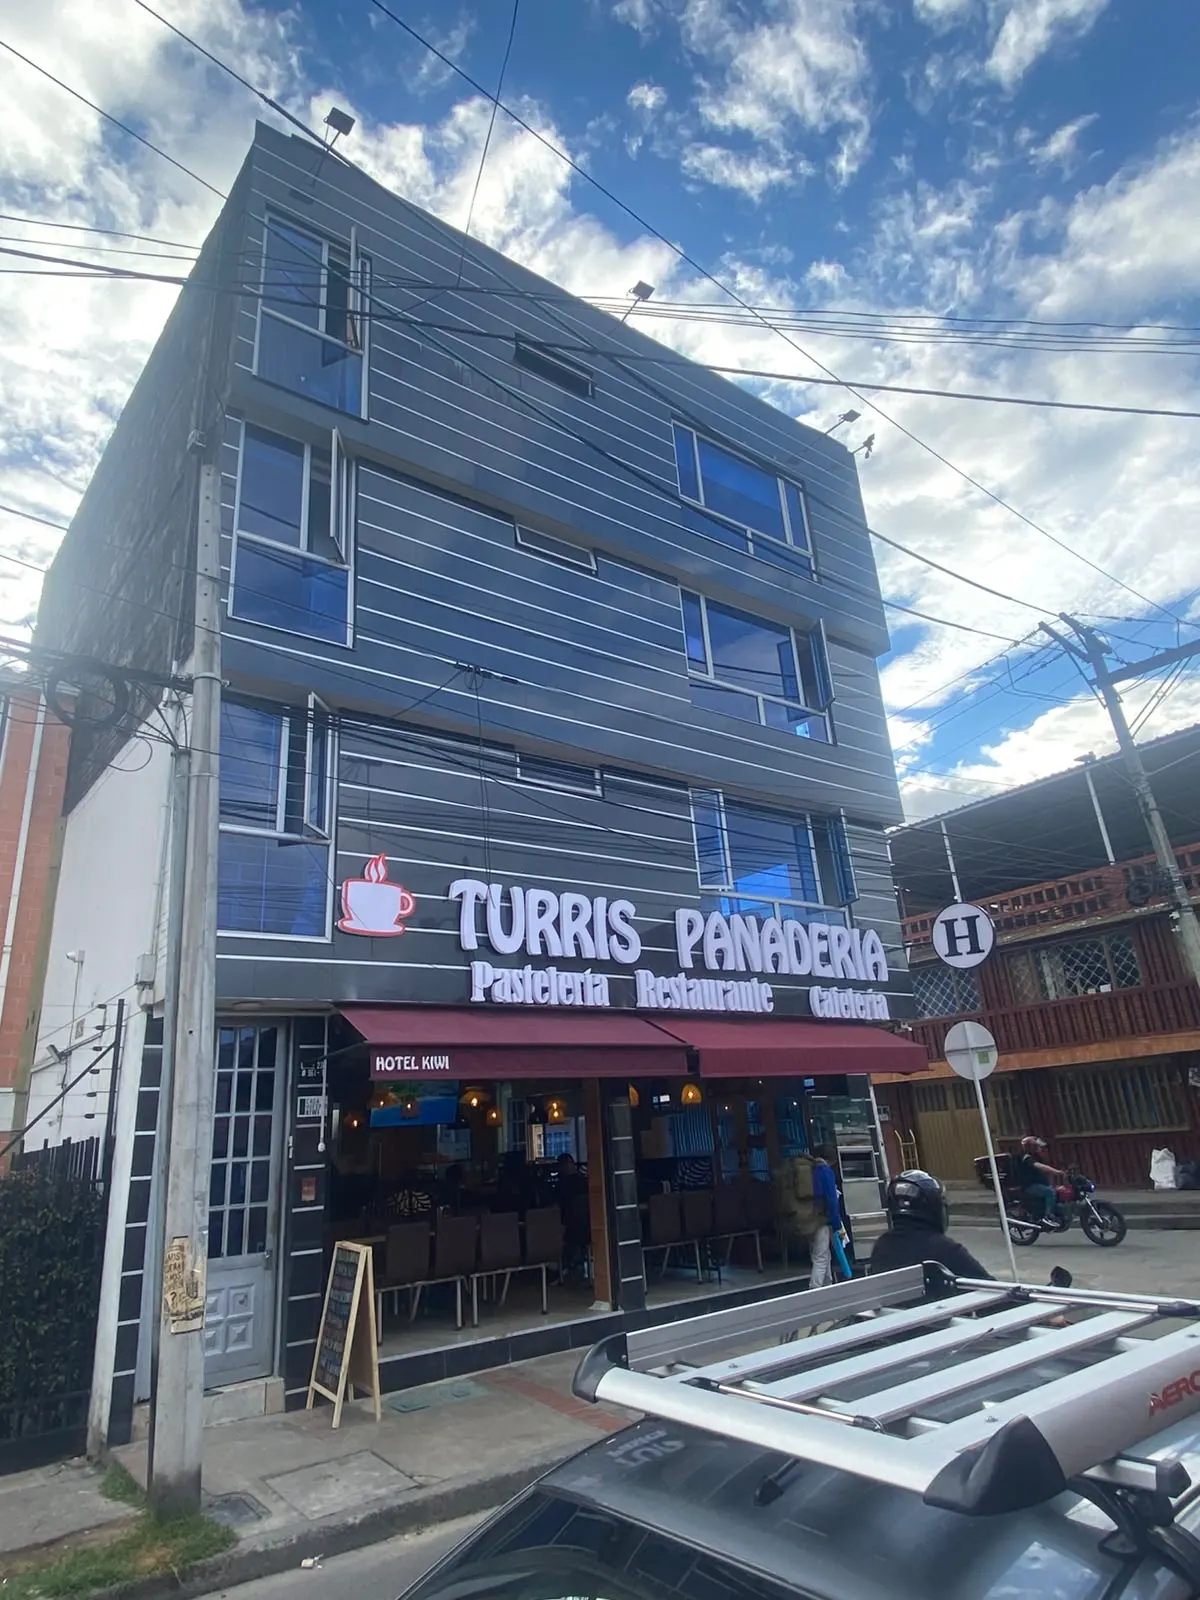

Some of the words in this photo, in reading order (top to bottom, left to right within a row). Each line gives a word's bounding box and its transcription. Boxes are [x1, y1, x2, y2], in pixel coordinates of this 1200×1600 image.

[449, 879, 642, 964] TURRIS
[675, 908, 889, 982] PANADERIA
[940, 915, 985, 957] H
[470, 961, 610, 1006] Pastelería
[634, 969, 774, 1012] Restaurante
[375, 1056, 419, 1071] HOTEL
[422, 1055, 450, 1070] KIWI
